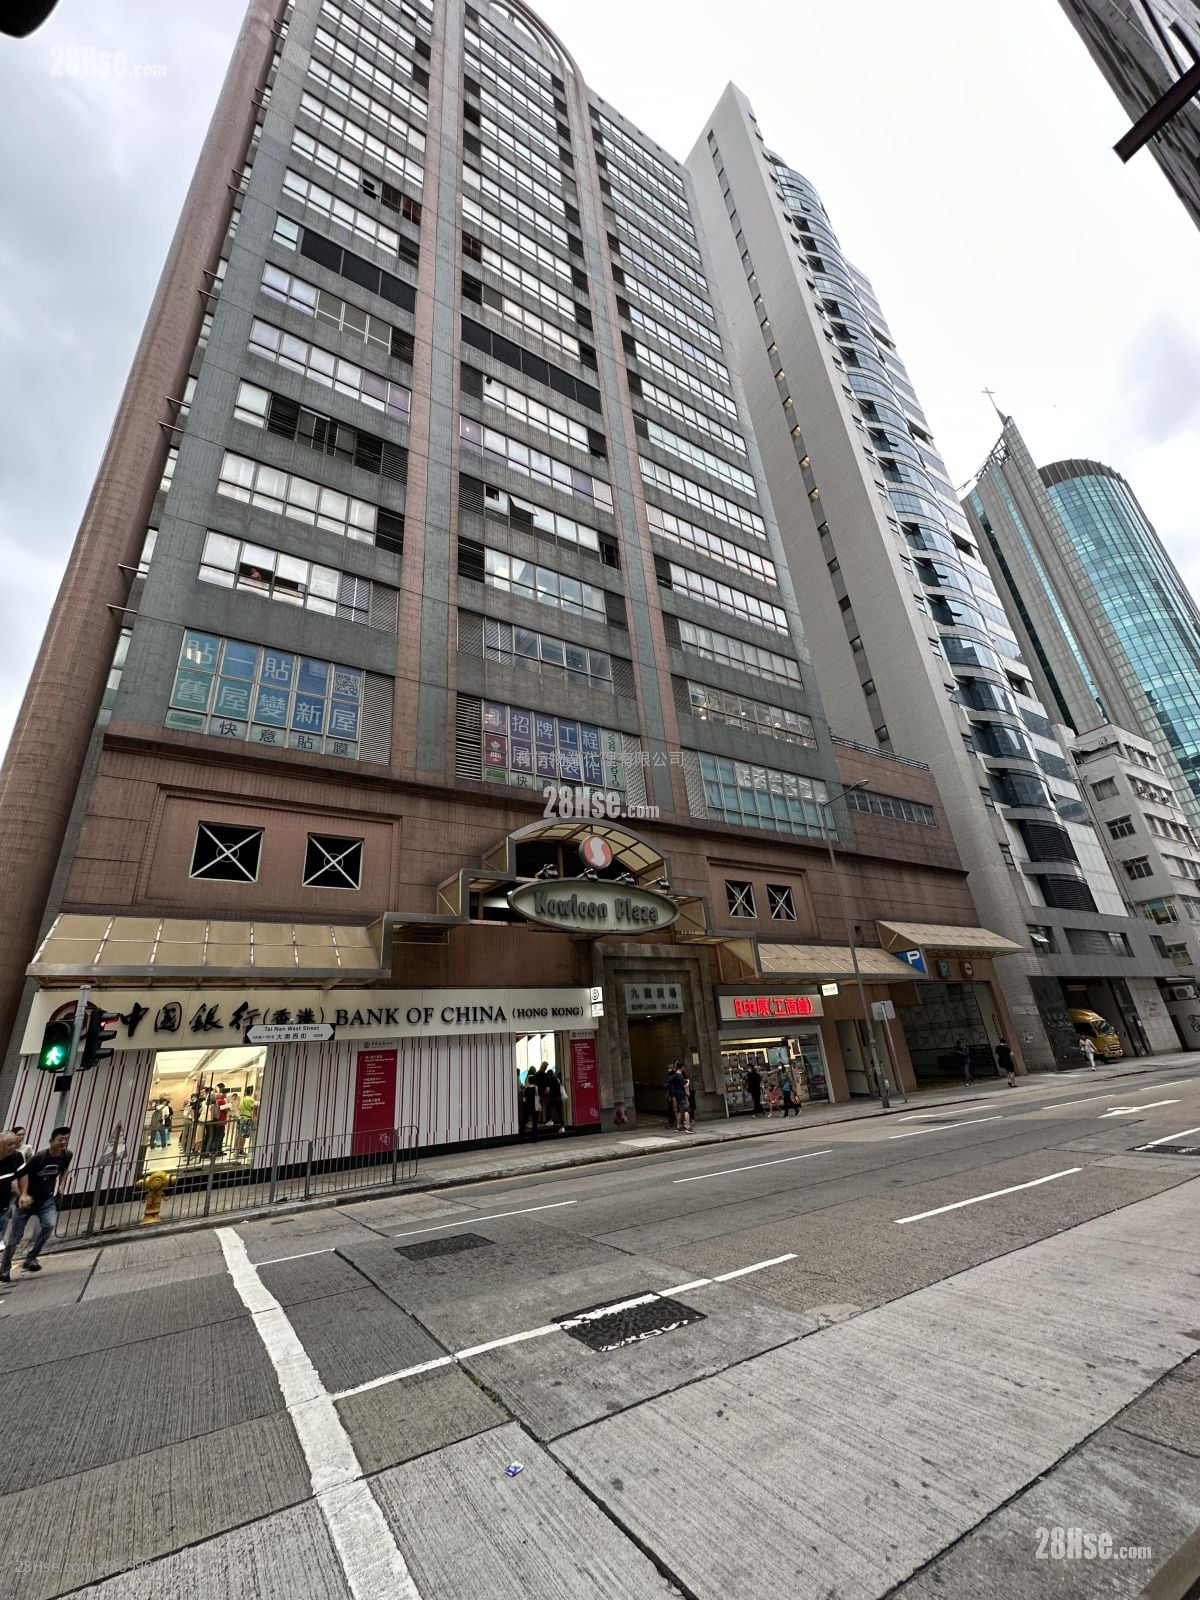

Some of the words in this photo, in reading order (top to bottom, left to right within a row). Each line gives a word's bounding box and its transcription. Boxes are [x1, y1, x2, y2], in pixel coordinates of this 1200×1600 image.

[177, 678, 357, 734] 舊屋變新屋
[219, 720, 349, 756] 快意貼膜
[511, 714, 599, 750] 招牌工程
[533, 891, 609, 920] Kowloon
[615, 897, 659, 922] Plaza
[906, 950, 920, 965] P
[335, 1007, 399, 1026] BANK
[406, 1007, 433, 1025] OF
[441, 1005, 507, 1023] CHINA
[512, 1006, 548, 1020] (HONG
[551, 1005, 585, 1018] KONG)
[276, 1032, 307, 1040] 大南西街
